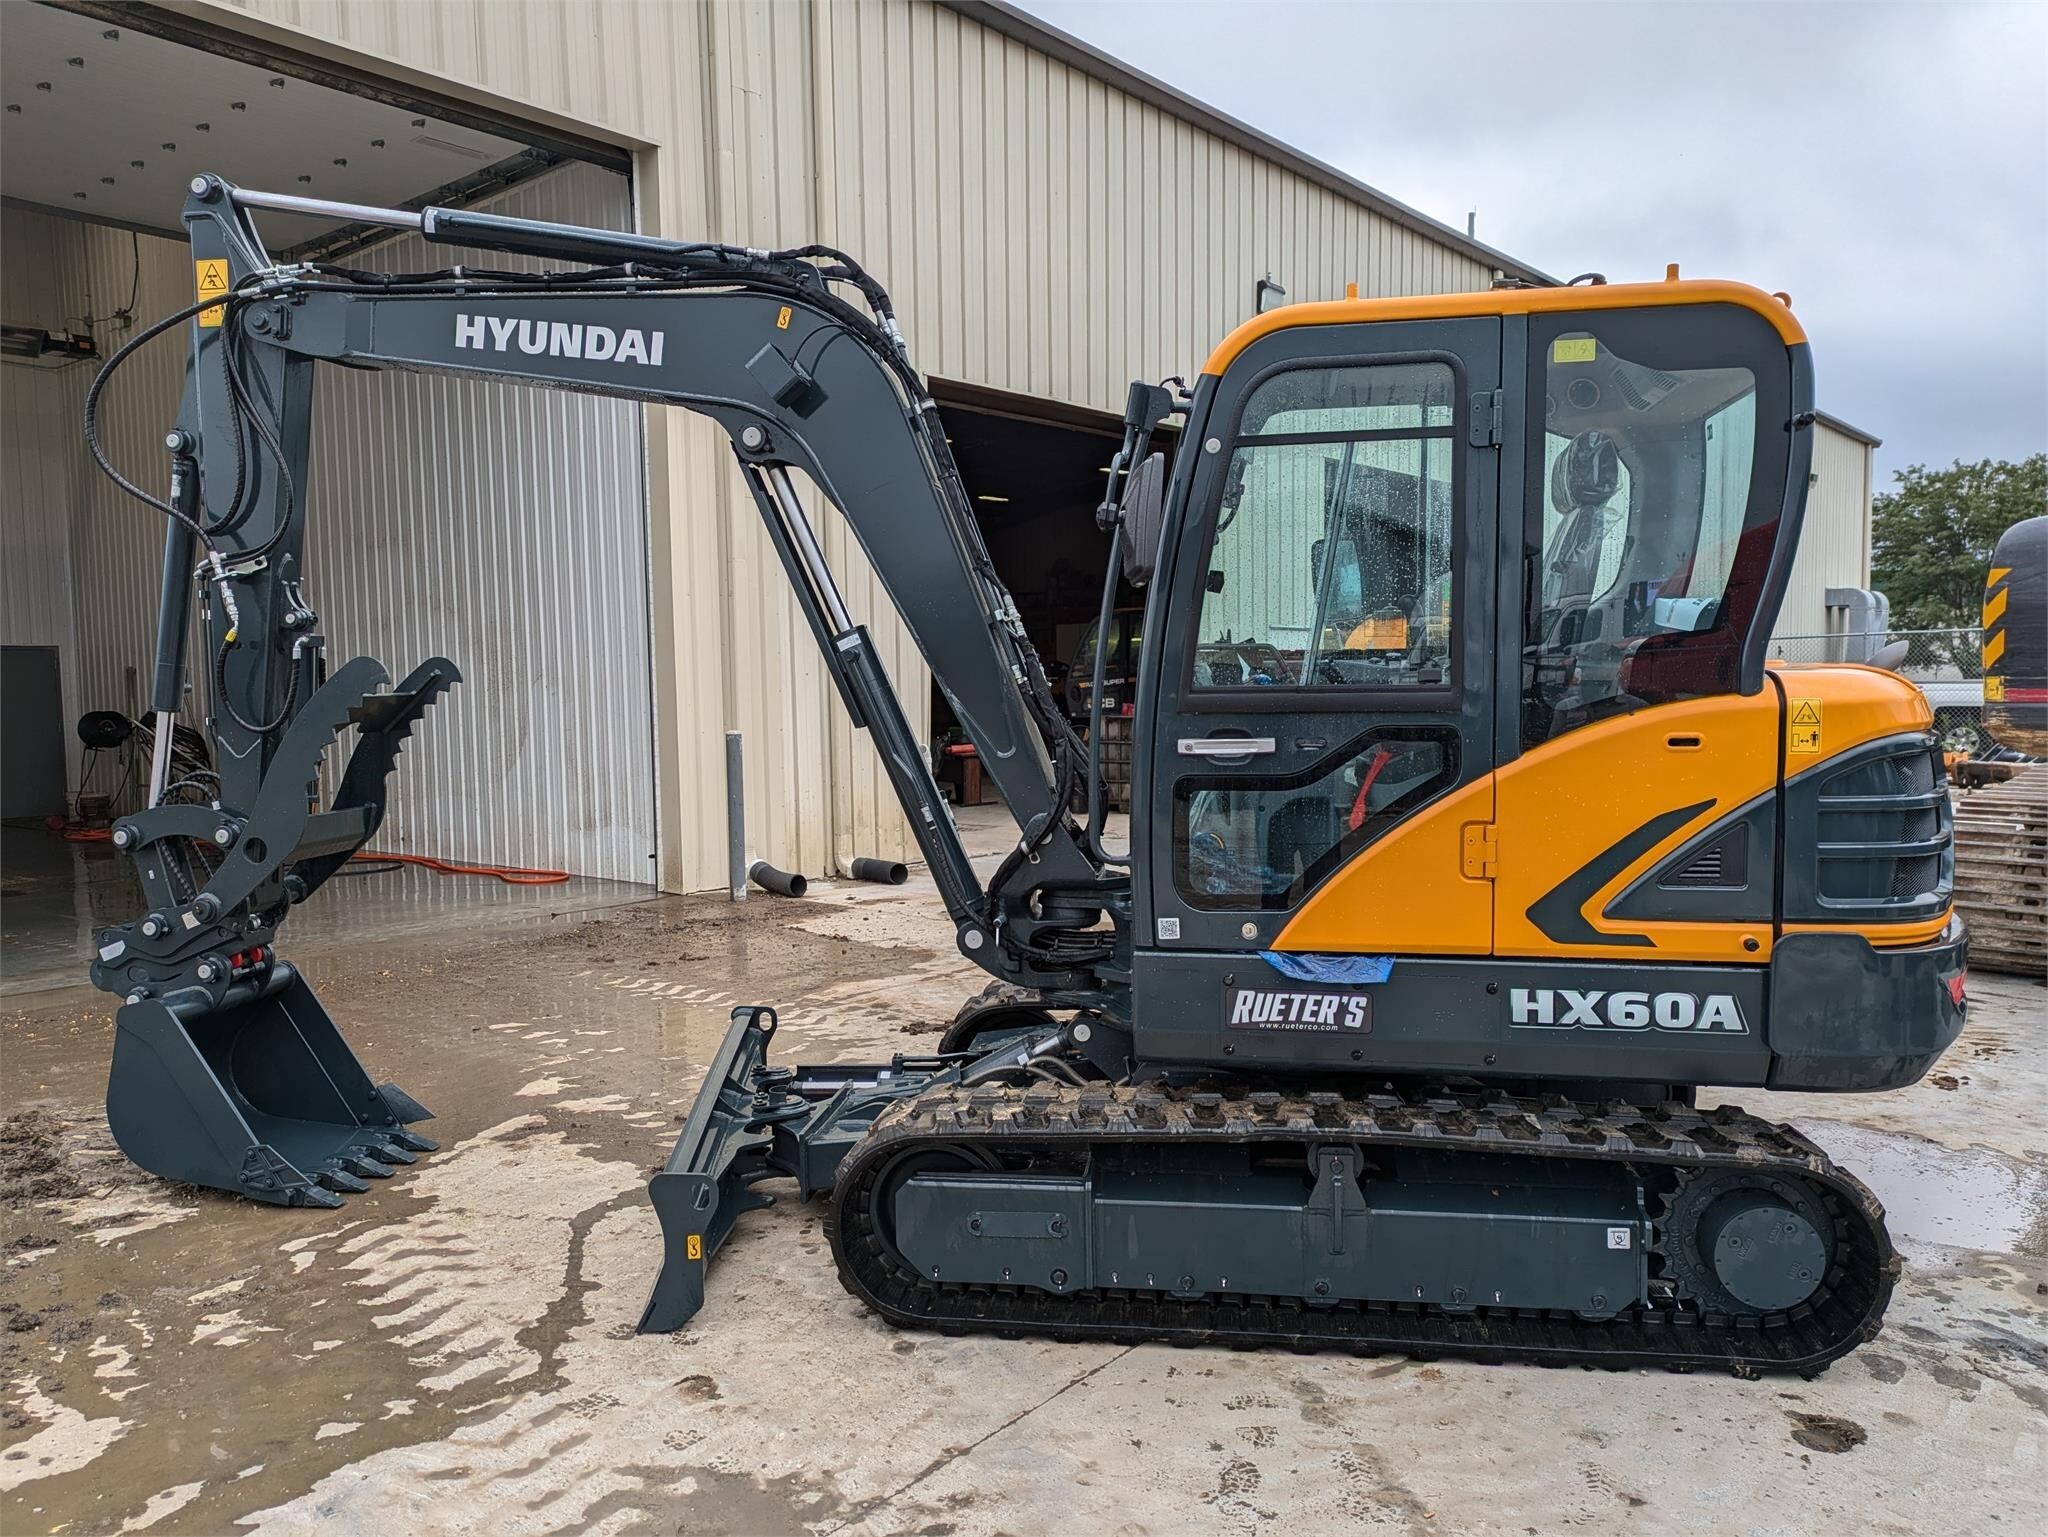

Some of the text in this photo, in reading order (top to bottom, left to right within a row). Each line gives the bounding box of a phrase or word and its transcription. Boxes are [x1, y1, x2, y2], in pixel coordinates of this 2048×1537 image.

[455, 314, 664, 366] HYUNDAI
[1231, 990, 1368, 1028] RUETER'S
[1259, 1022, 1339, 1031] www.rueterco.com
[1510, 988, 1744, 1031] HX60A
